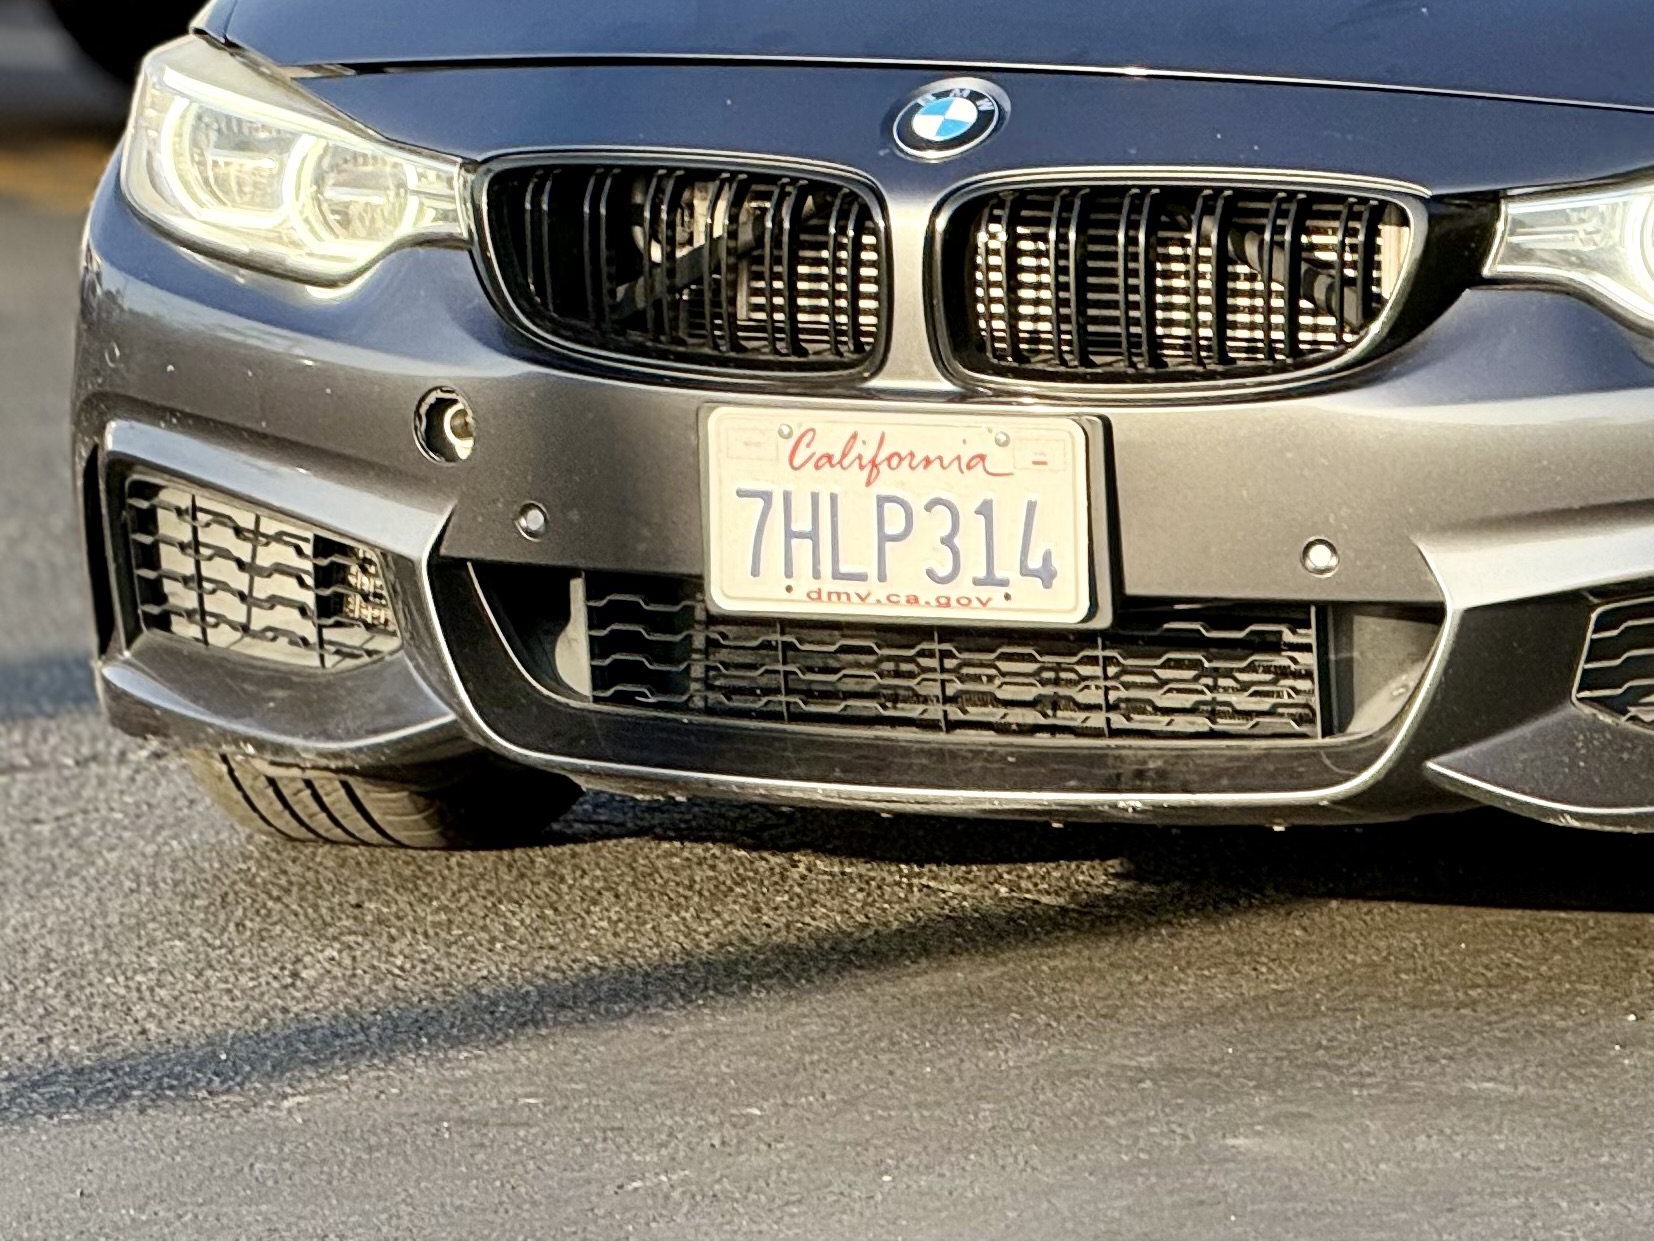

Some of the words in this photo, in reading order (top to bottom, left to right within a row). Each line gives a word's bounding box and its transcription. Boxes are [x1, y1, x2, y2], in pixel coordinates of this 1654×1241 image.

[787, 428, 1013, 486] California
[736, 488, 1058, 589] 7HLP314
[806, 588, 993, 608] dmv.ca.gov
